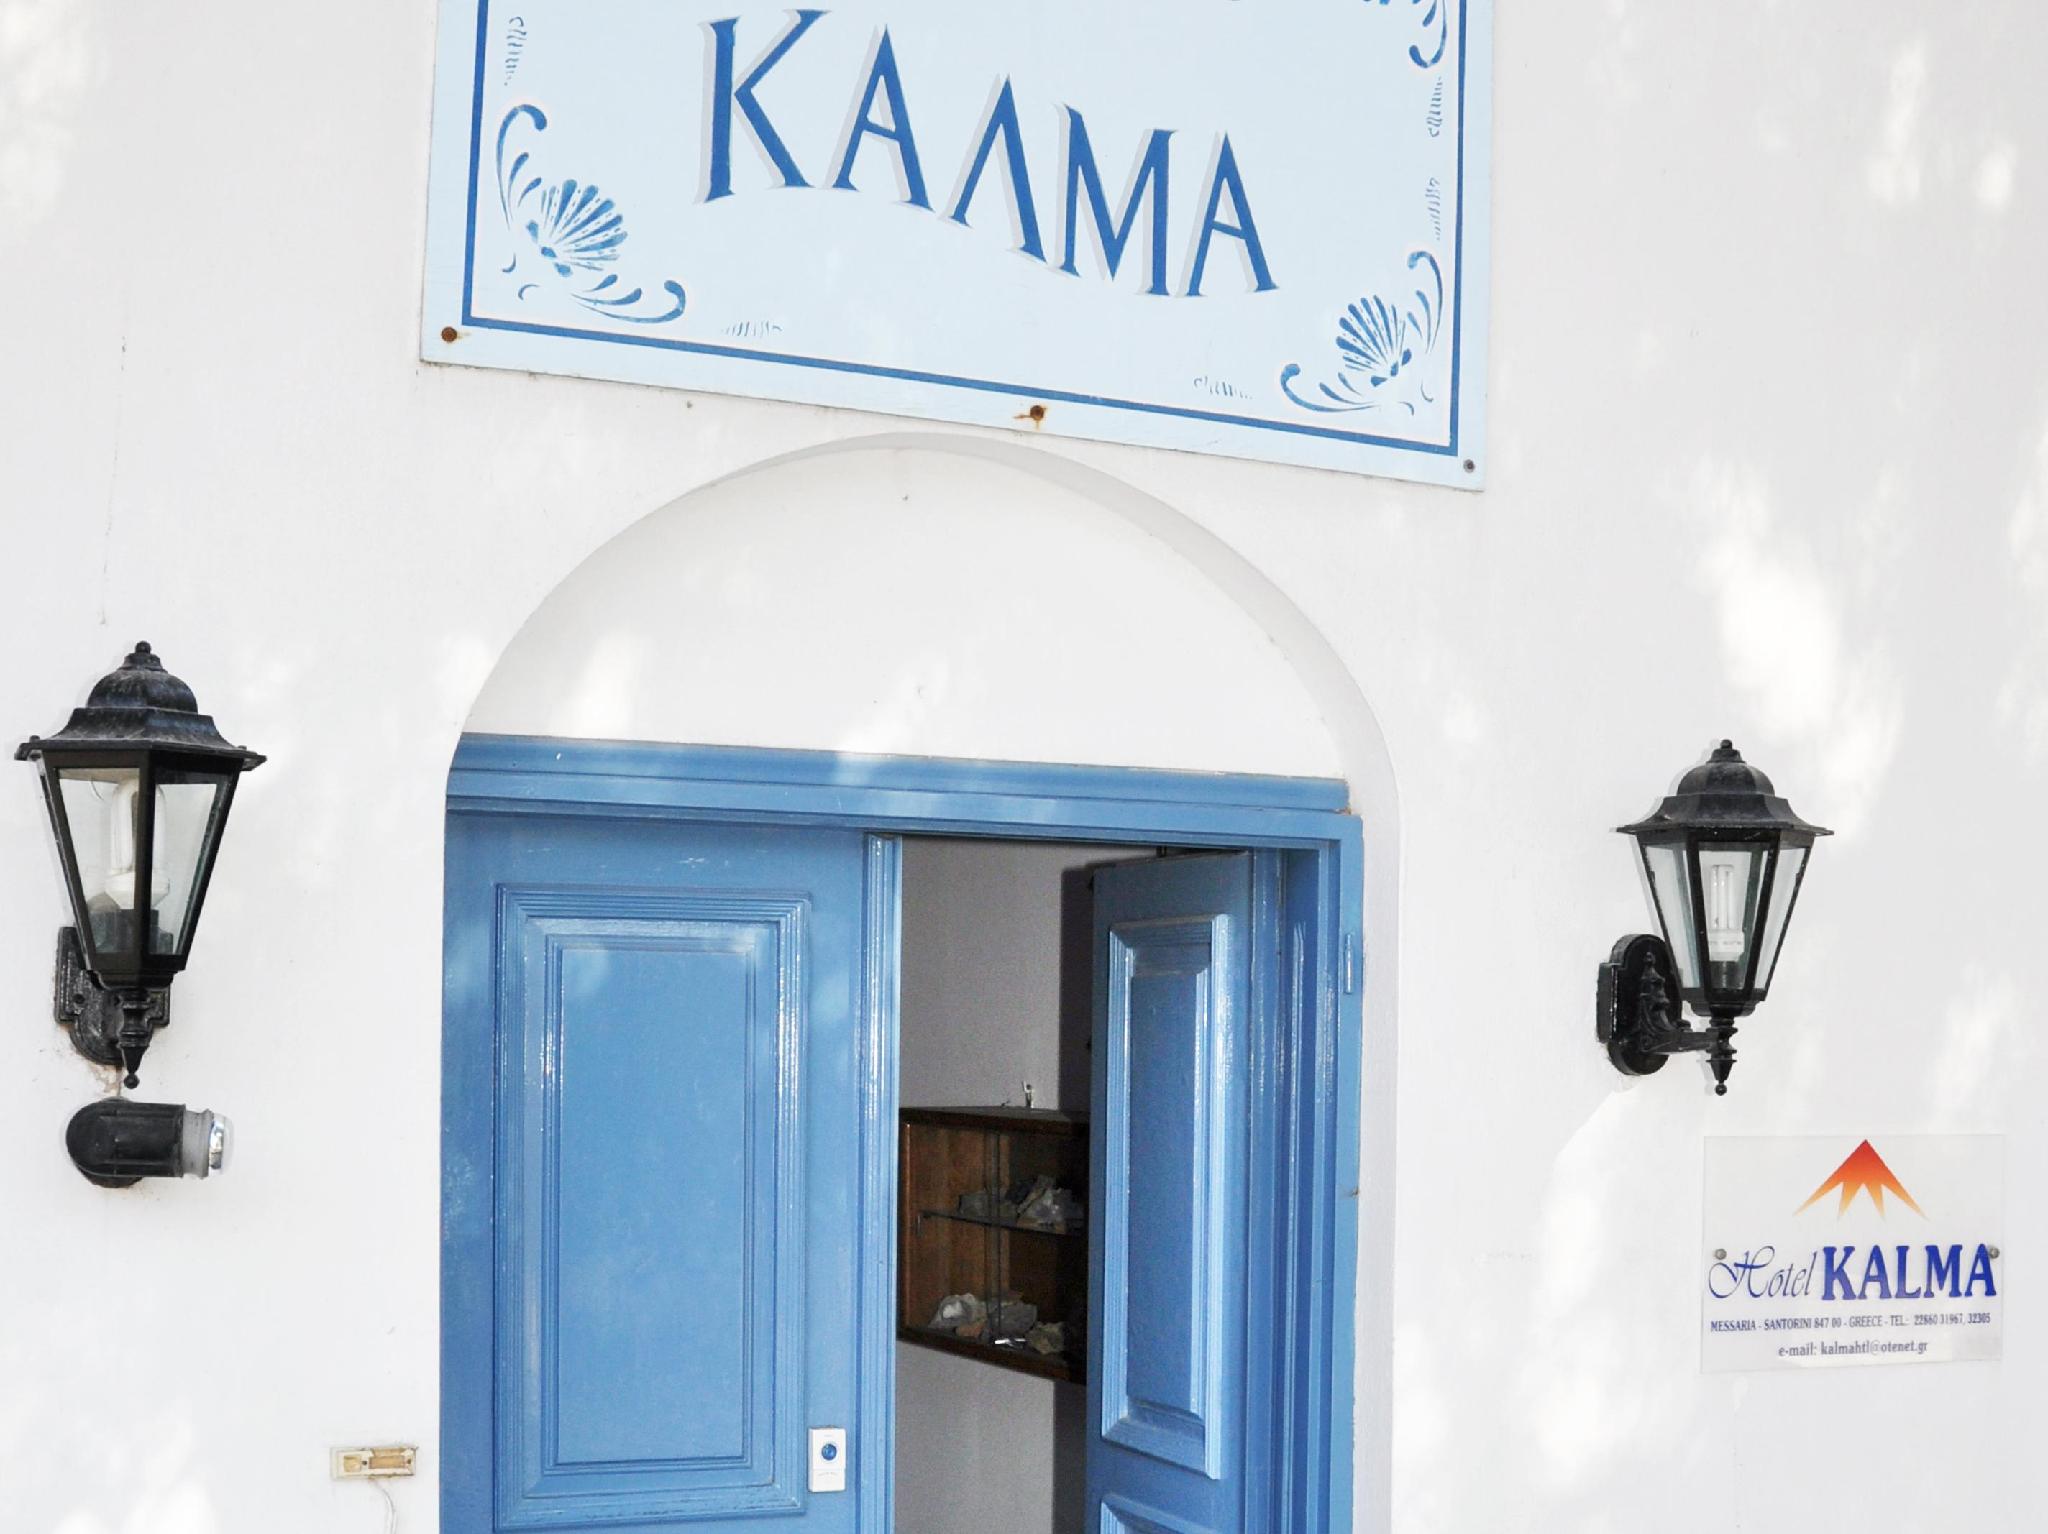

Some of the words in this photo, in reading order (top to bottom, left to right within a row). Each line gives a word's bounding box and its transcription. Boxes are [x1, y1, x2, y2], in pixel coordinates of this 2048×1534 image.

[699, 9, 1278, 297] ΚΑΛΜΑ
[1708, 1245, 1818, 1299] Hotel
[1821, 1243, 1997, 1300] KALMA
[1710, 1319, 1756, 1332] MESSARIA
[1763, 1318, 1812, 1330] SANTORINI
[1814, 1317, 1829, 1328] 847
[1849, 1315, 1883, 1328] GREECE
[1778, 1341, 1817, 1356] e-mail:
